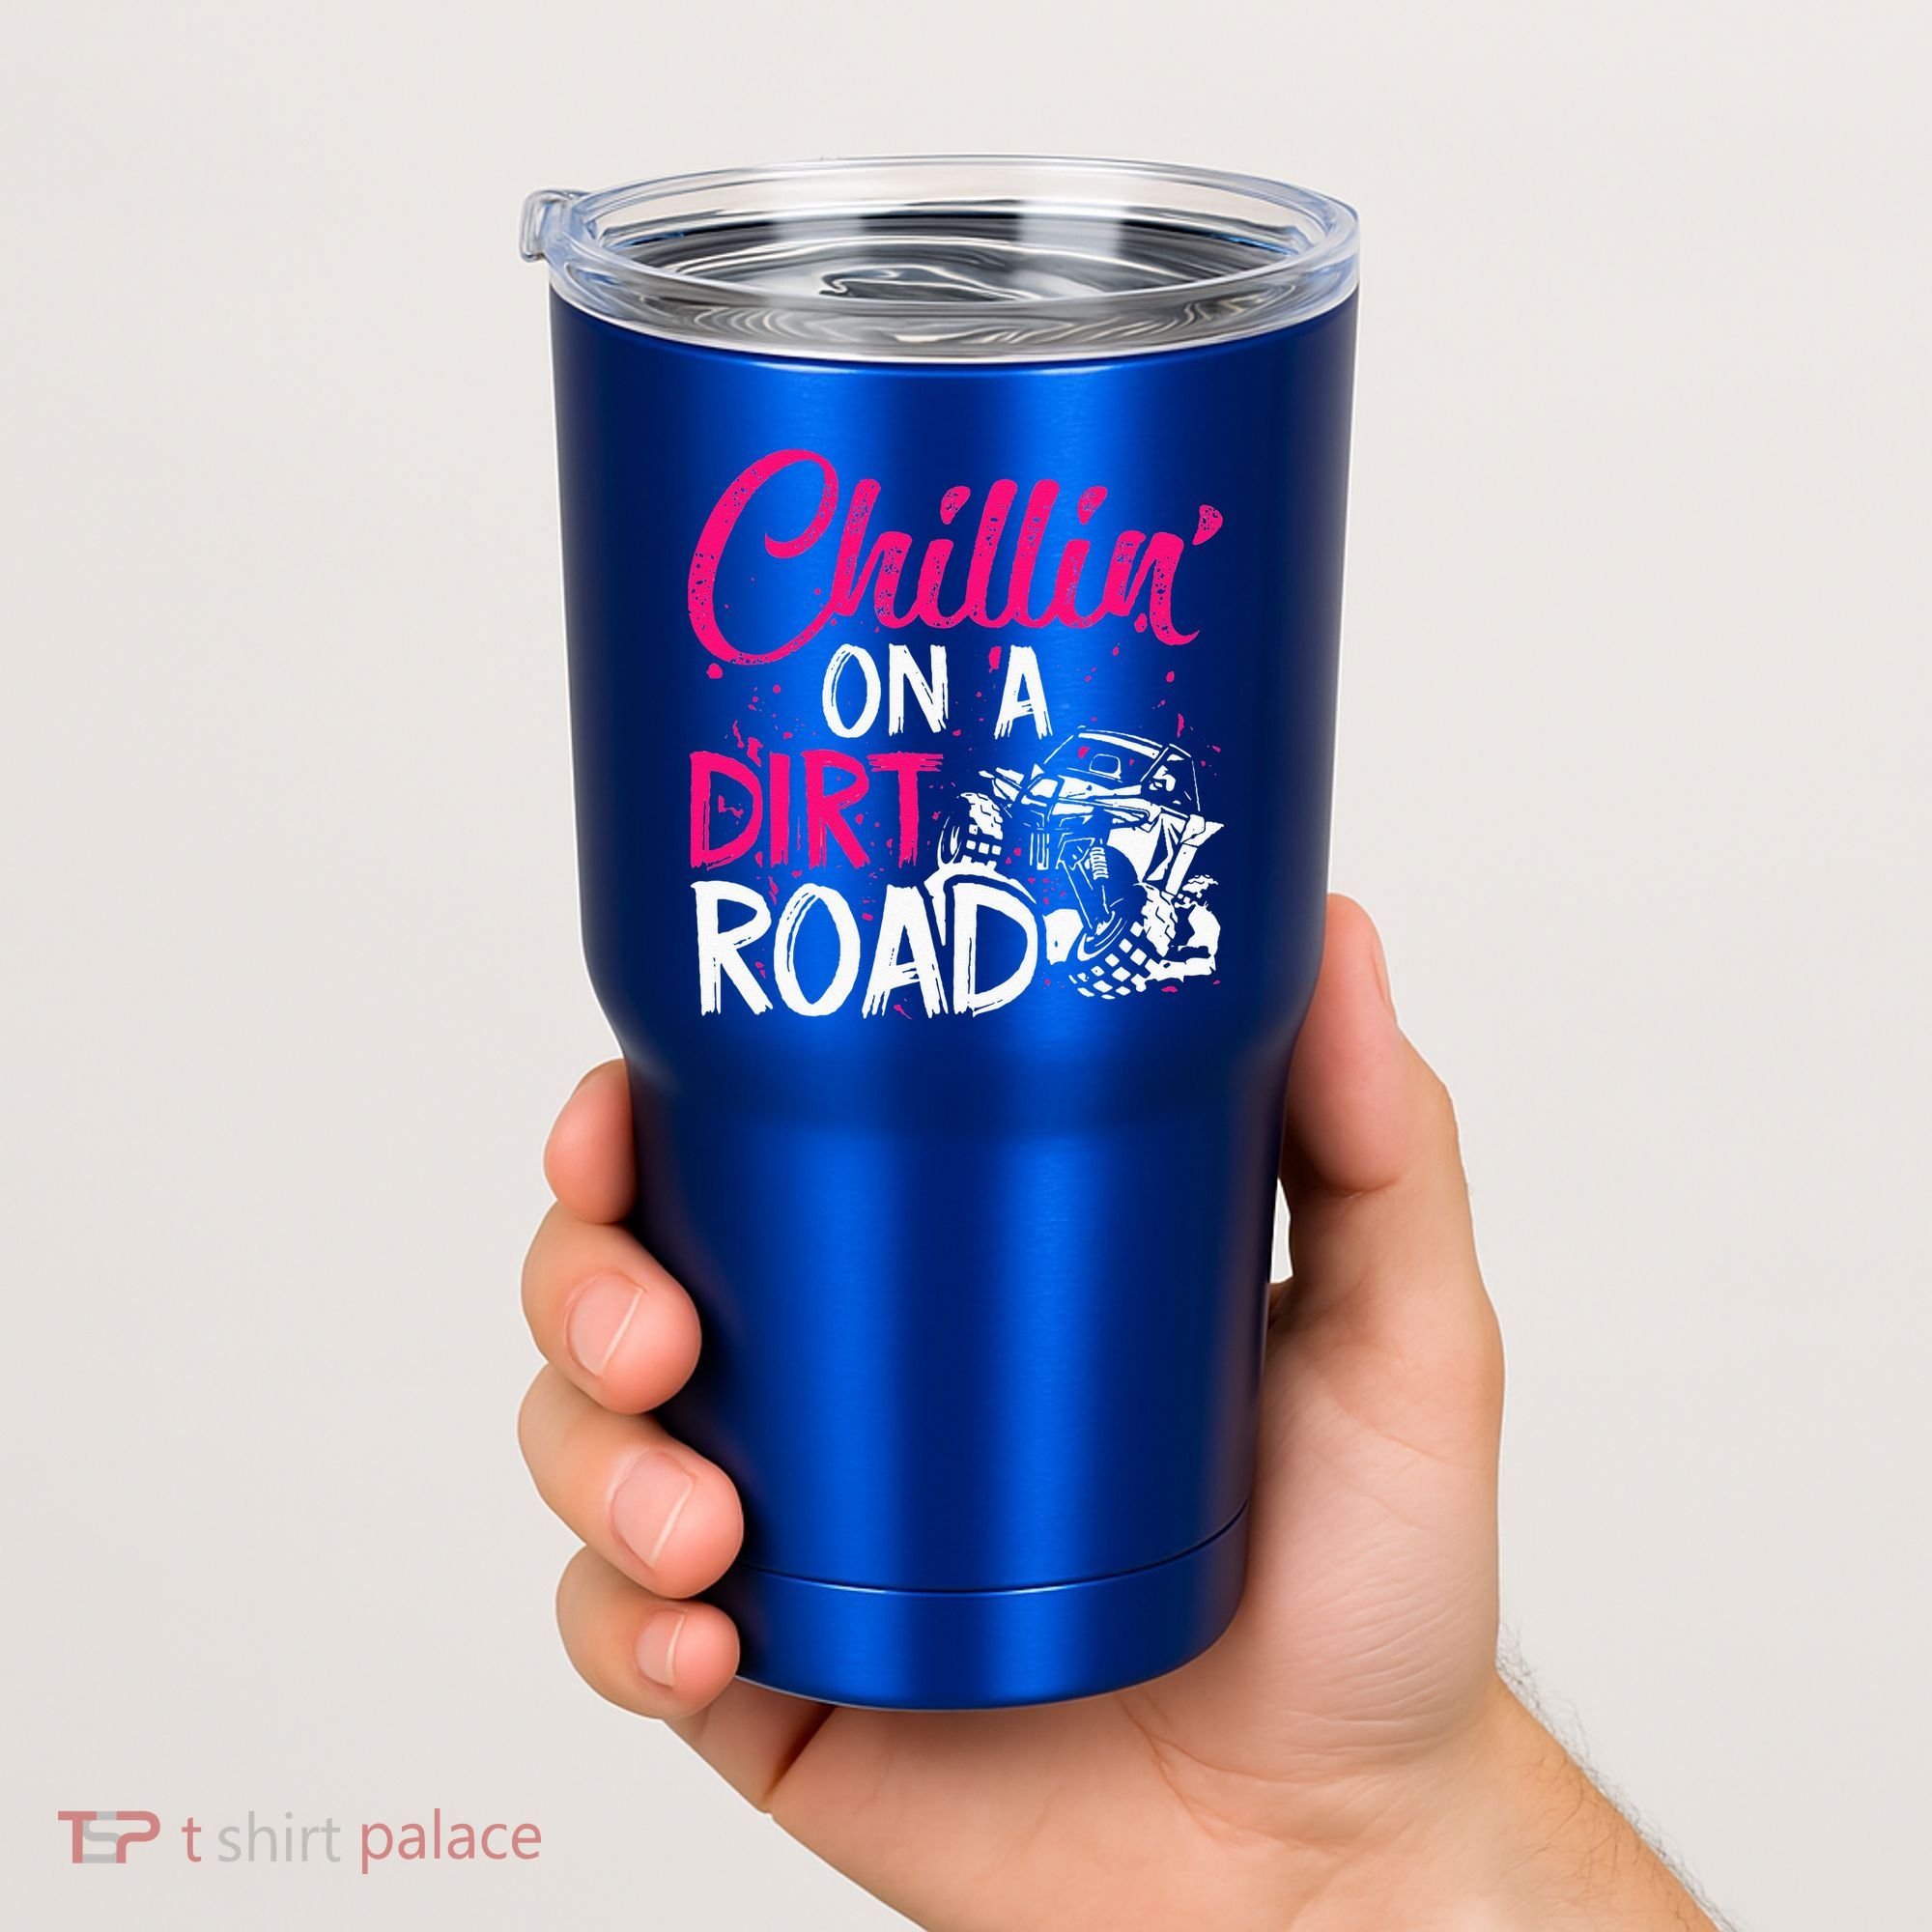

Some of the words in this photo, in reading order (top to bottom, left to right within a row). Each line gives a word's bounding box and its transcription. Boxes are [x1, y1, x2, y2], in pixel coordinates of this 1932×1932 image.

[688, 448, 1224, 666] Chillin'
[822, 643, 949, 738] ON
[995, 645, 1053, 739] A
[690, 750, 944, 868] DIRT
[691, 880, 1038, 1019] ROAD
